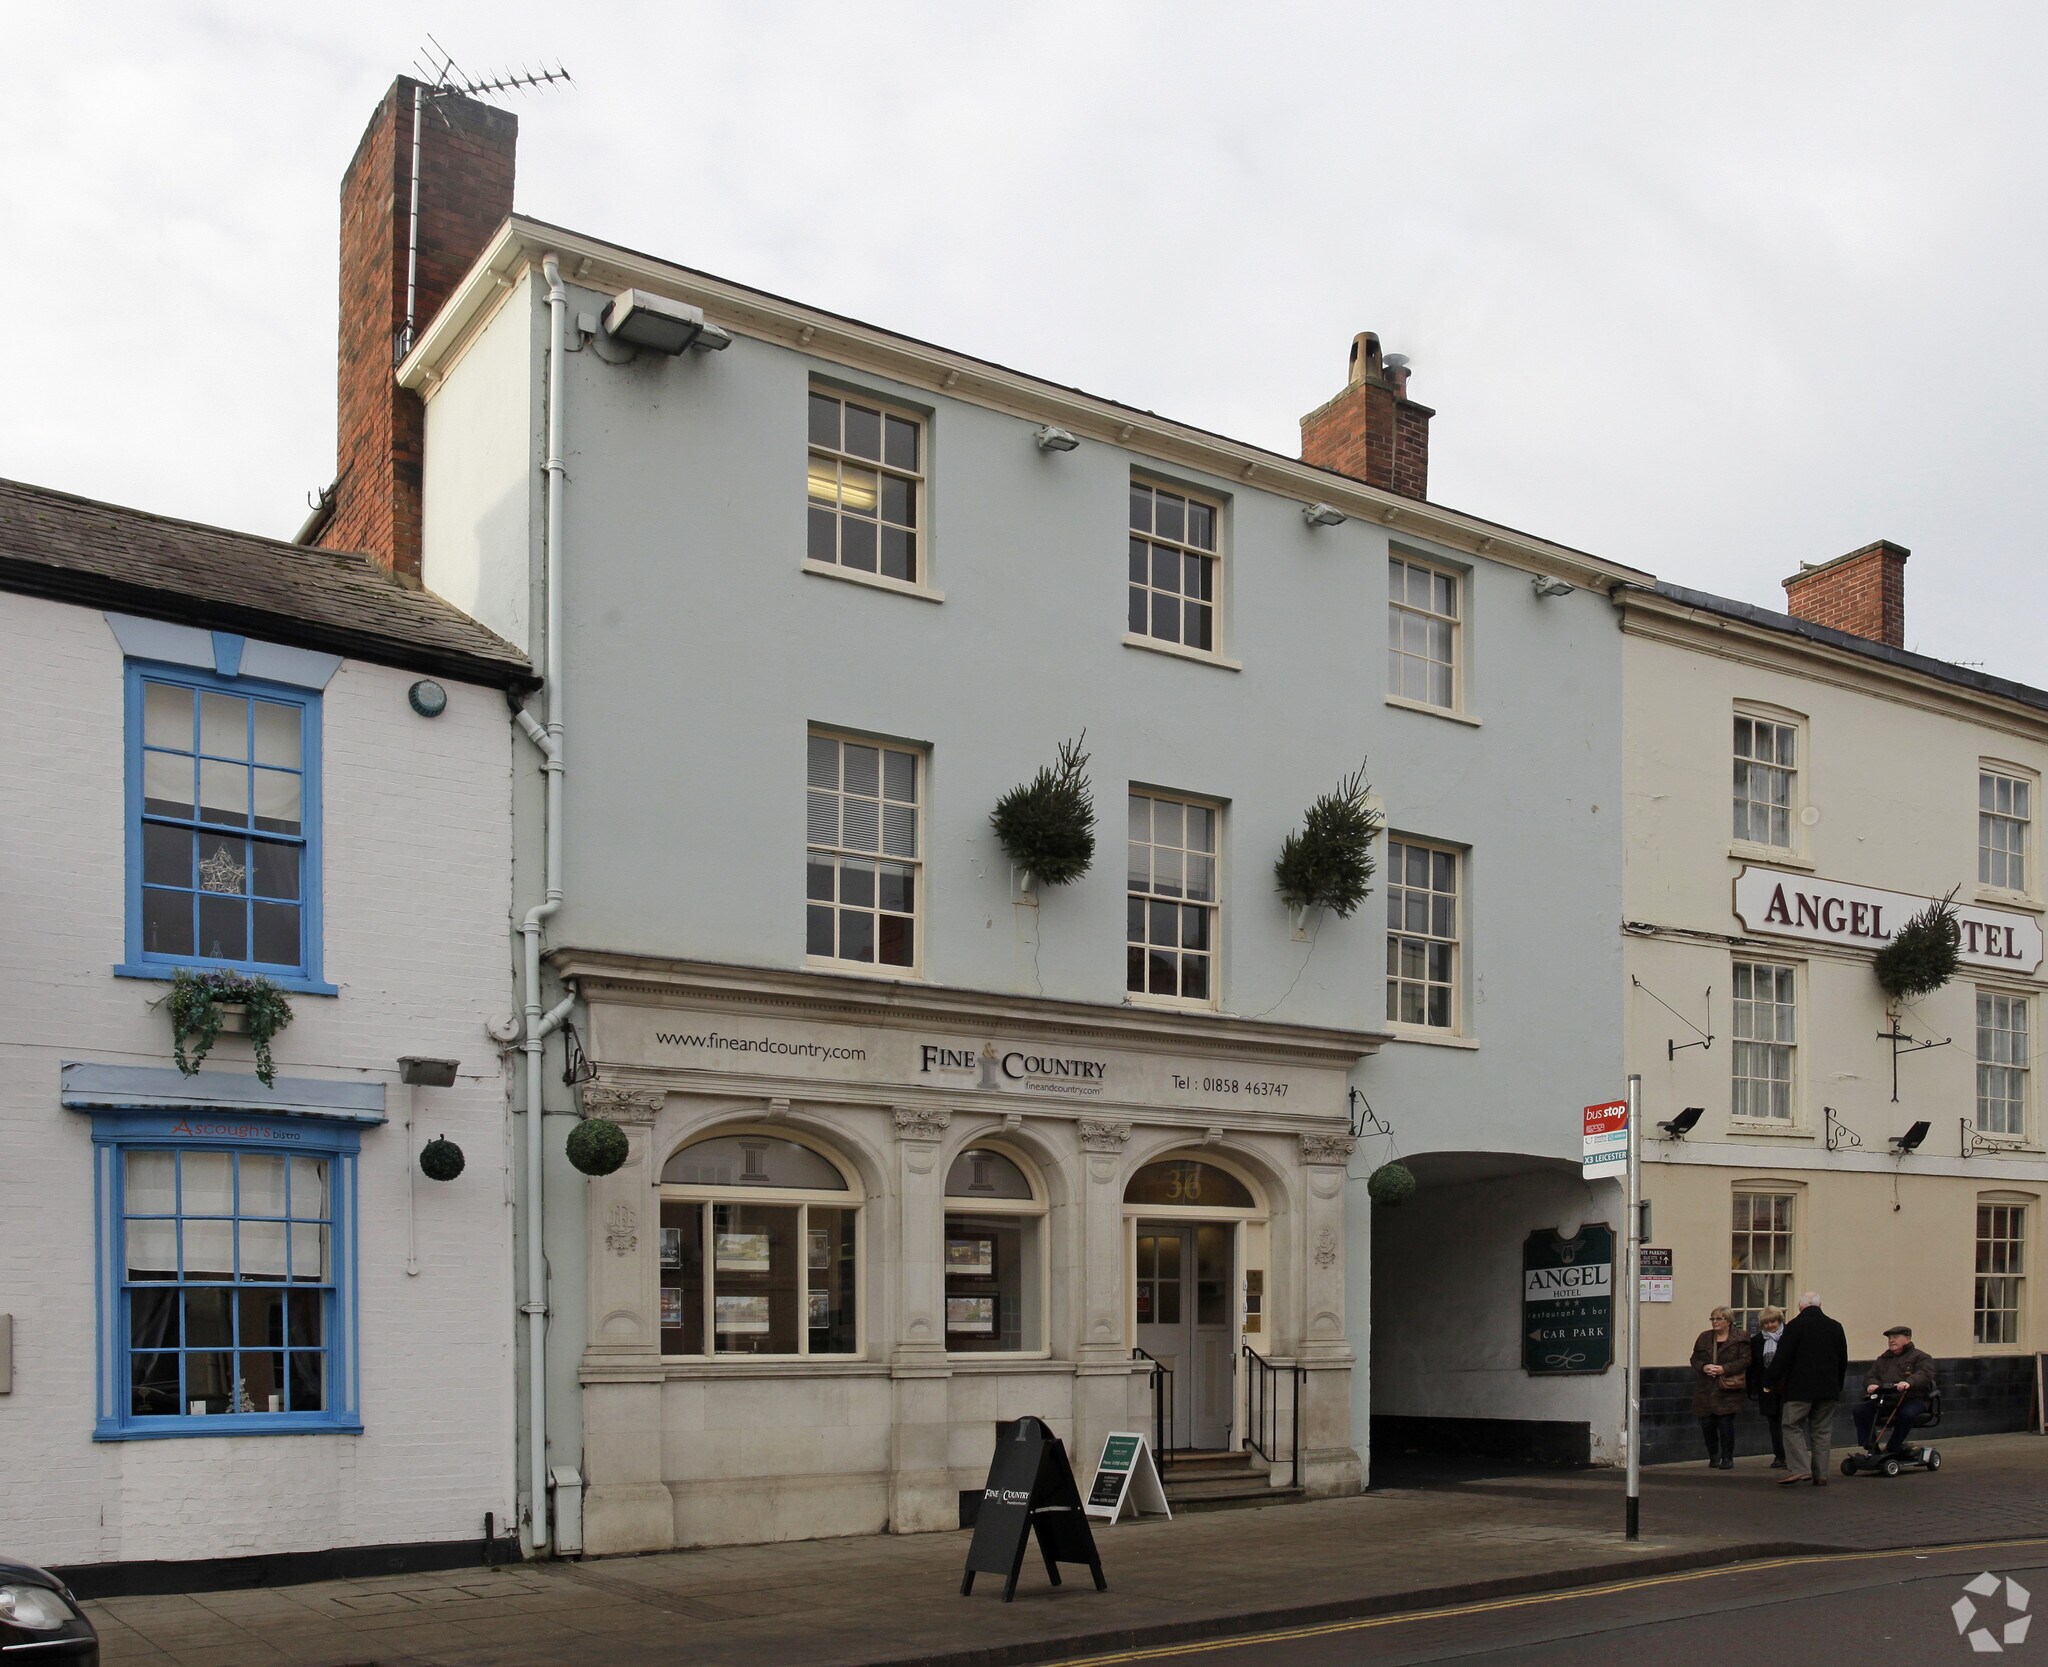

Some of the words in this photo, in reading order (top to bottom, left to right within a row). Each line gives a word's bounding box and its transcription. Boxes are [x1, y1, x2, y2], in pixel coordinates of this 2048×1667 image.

[1764, 882, 1891, 940] ANGEL
[656, 1032, 866, 1062] www.fineandcountry.com
[920, 1044, 976, 1073] FINE
[1002, 1052, 1107, 1079] COUNTRY
[1025, 1080, 1101, 1096] fineandcountry.com
[1171, 1074, 1190, 1090] Tel
[1203, 1077, 1239, 1093] 01858
[1244, 1081, 1289, 1097] 463747
[1586, 1108, 1603, 1121] bus
[1603, 1105, 1625, 1119] stop
[171, 1119, 272, 1138] Ascough's
[273, 1130, 300, 1141] bistro
[1584, 1155, 1594, 1164] X3
[1595, 1151, 1627, 1163] LEICESTER
[1528, 1265, 1608, 1290] ANGEL
[1553, 1289, 1581, 1298] HOTEL
[1527, 1309, 1575, 1319] restaurant
[1580, 1308, 1586, 1316] &
[1592, 1306, 1607, 1315] bar
[1543, 1329, 1565, 1339] CAR
[1573, 1327, 1604, 1337] PARK
[1002, 1489, 1030, 1501] COUNTRY
